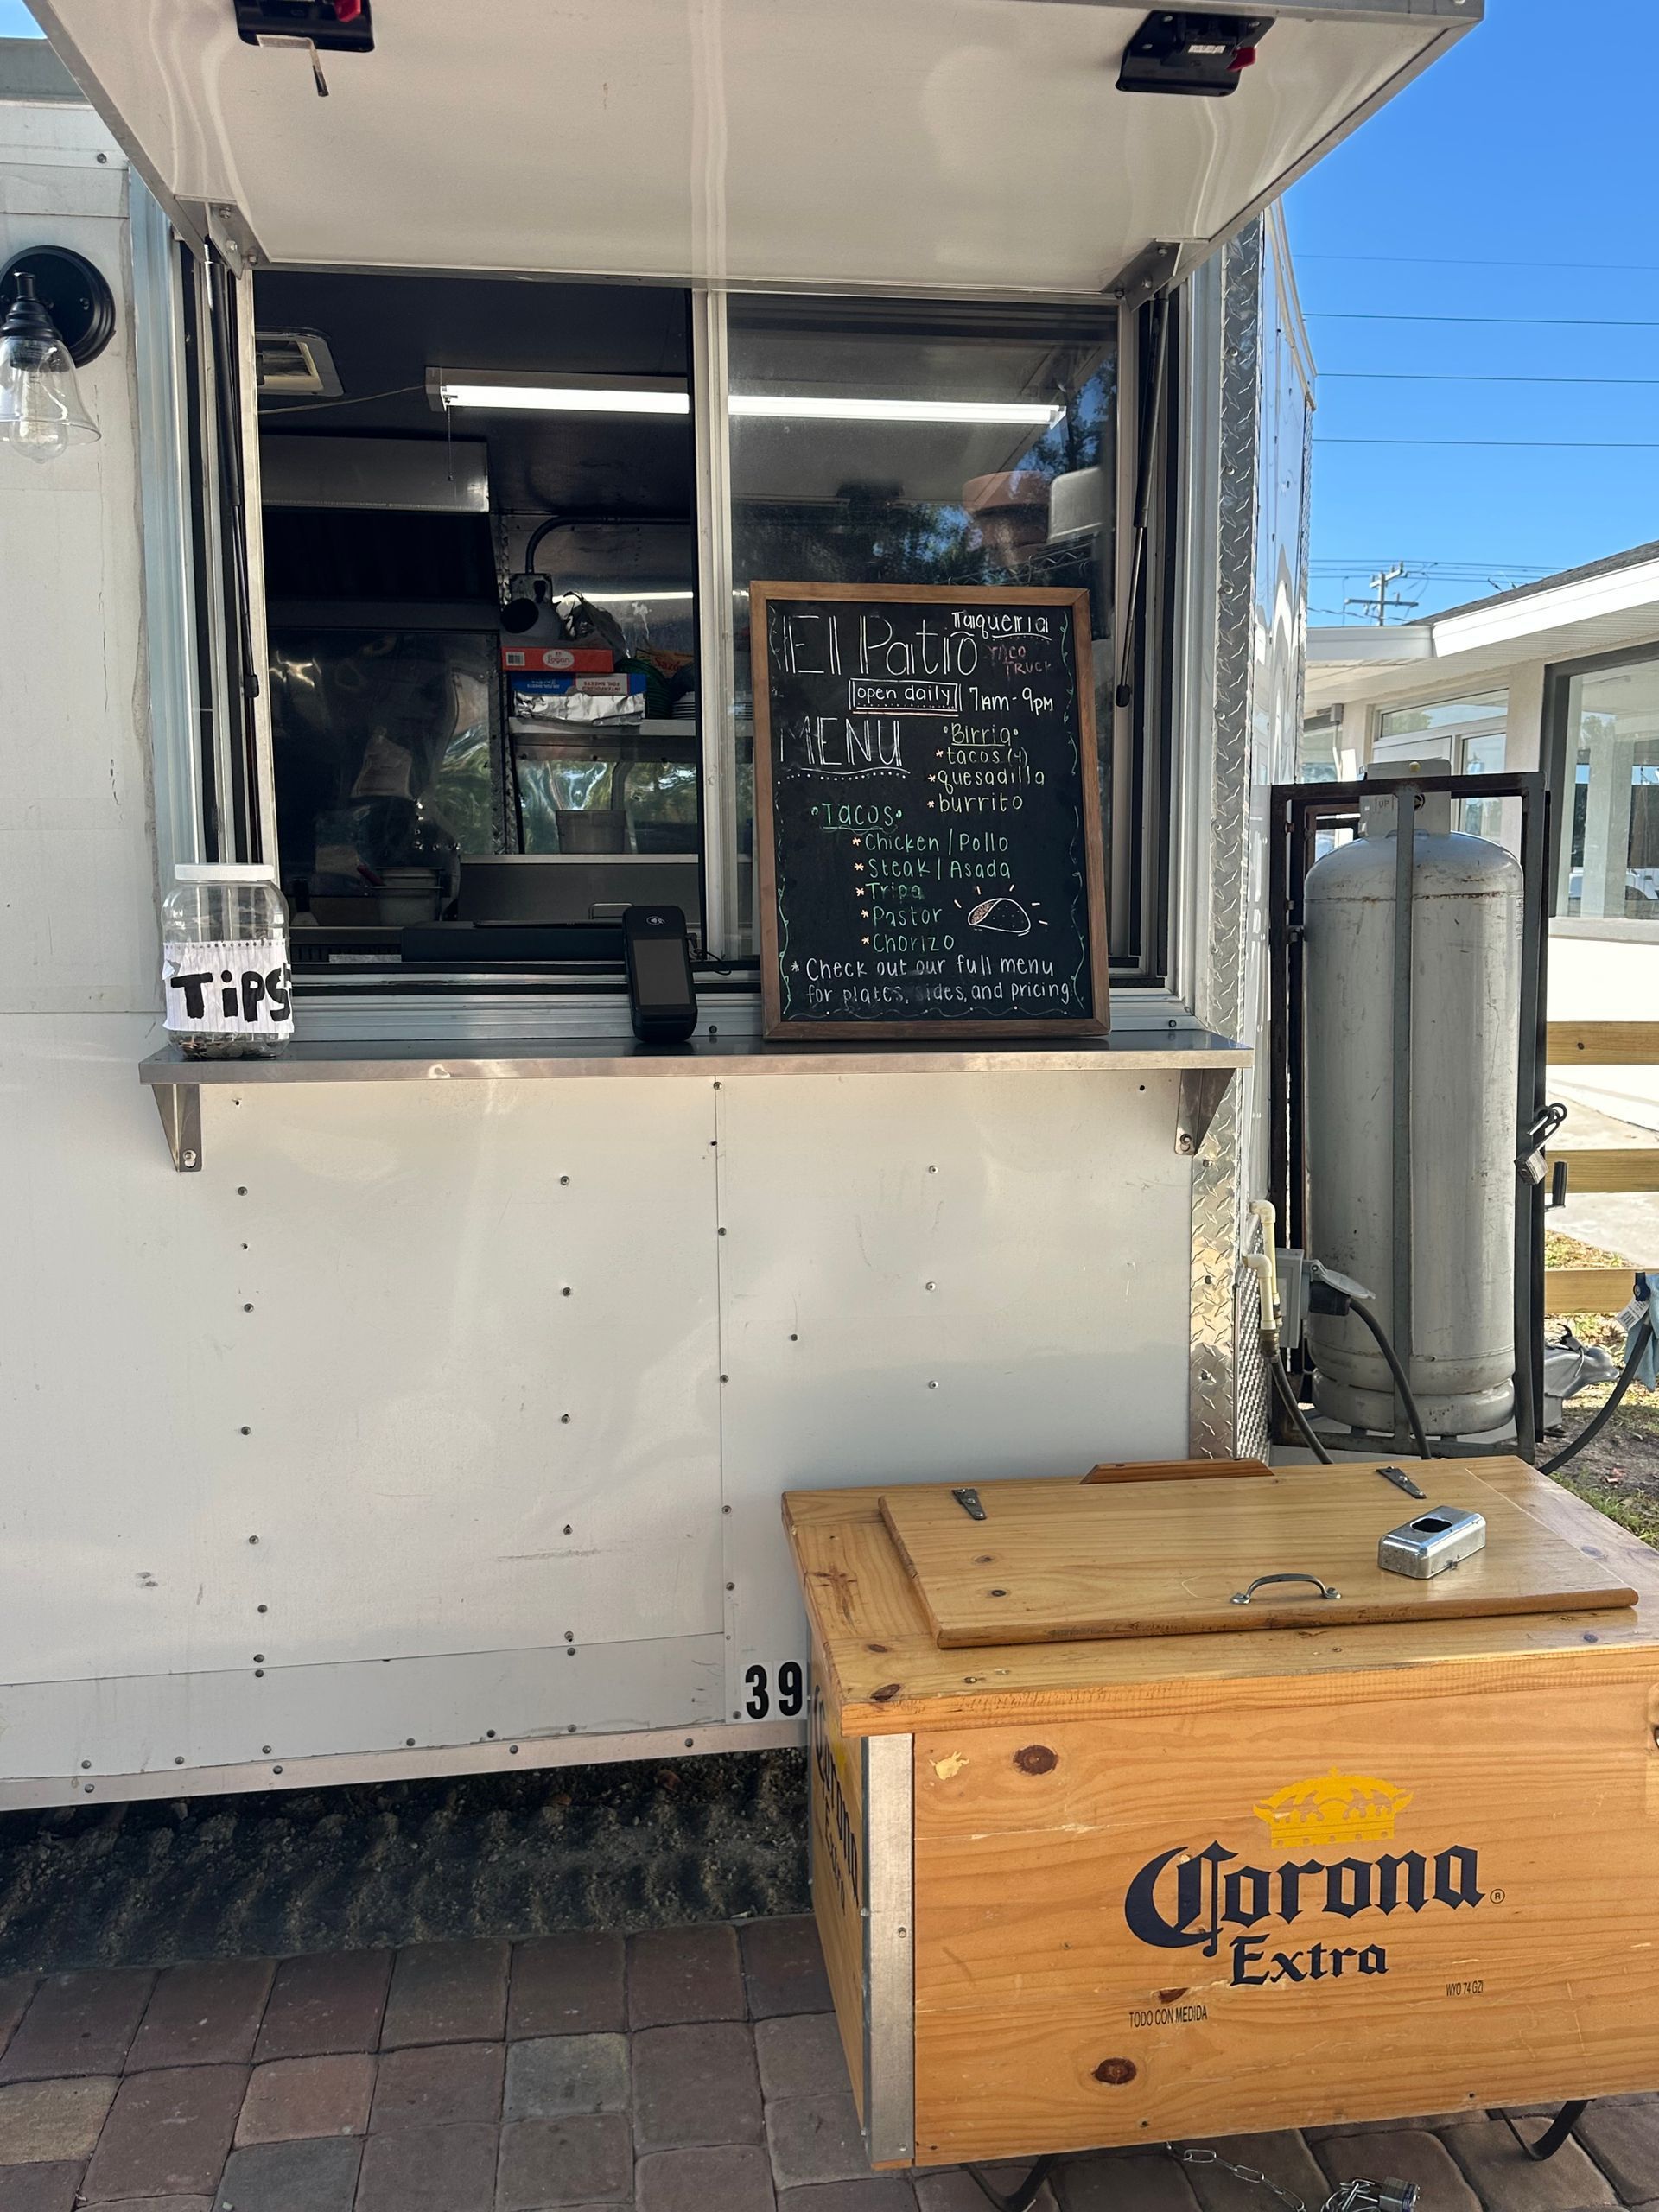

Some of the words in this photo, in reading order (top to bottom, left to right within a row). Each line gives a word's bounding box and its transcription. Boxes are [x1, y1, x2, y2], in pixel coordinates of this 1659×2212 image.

[951, 611, 1049, 639] Taqueria
[782, 614, 842, 676] El
[859, 614, 978, 677] Patio
[857, 684, 896, 703] open
[905, 683, 950, 705] daily
[780, 716, 903, 767] MENU
[960, 832, 1009, 853] Pollo
[950, 860, 1012, 880] Asada
[806, 958, 868, 981] Check
[877, 959, 908, 976] out
[916, 960, 947, 975] our
[957, 955, 993, 975] full
[1000, 957, 1055, 977] menu
[806, 985, 835, 1005] for
[971, 982, 1003, 1000] and
[745, 1661, 803, 1720] 39
[1124, 1840, 1486, 1958] Corona
[1229, 1933, 1390, 1986] Extra
[1463, 1981, 1471, 1995] 74
[1128, 2011, 1153, 2028] TODO
[1154, 2008, 1173, 2025] CON
[1175, 2005, 1208, 2024] MEDIDA
